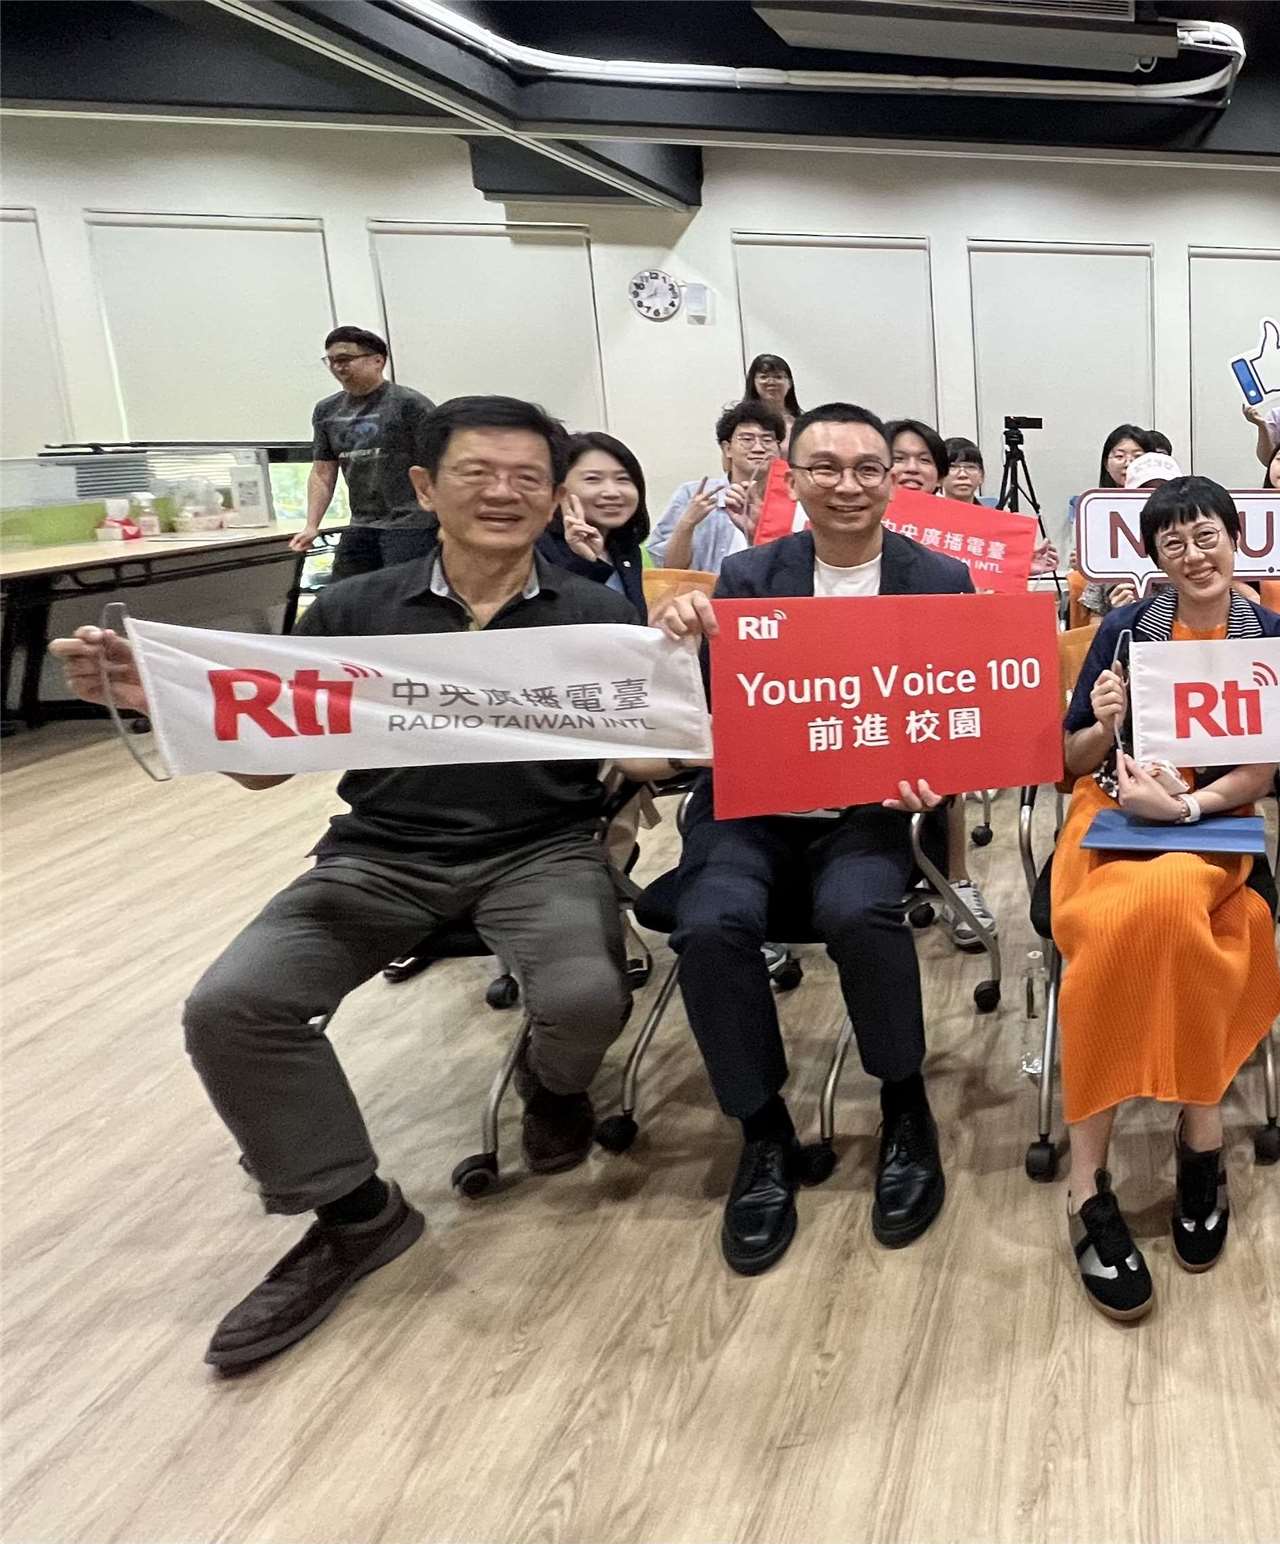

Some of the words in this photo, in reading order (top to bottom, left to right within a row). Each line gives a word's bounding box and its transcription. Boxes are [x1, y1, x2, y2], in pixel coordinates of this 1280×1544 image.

[738, 610, 787, 640] Rti
[208, 660, 383, 741] Rti
[392, 678, 649, 713] 中央廣播電臺
[736, 672, 861, 709] Young
[872, 663, 977, 698] Voice
[986, 657, 1041, 691] 100
[1173, 661, 1279, 739] Rti
[388, 713, 484, 732] RADIO
[489, 713, 596, 730] TAIWAN
[602, 716, 656, 730] INTL
[807, 713, 890, 752] 前進
[905, 707, 981, 743] 校園
